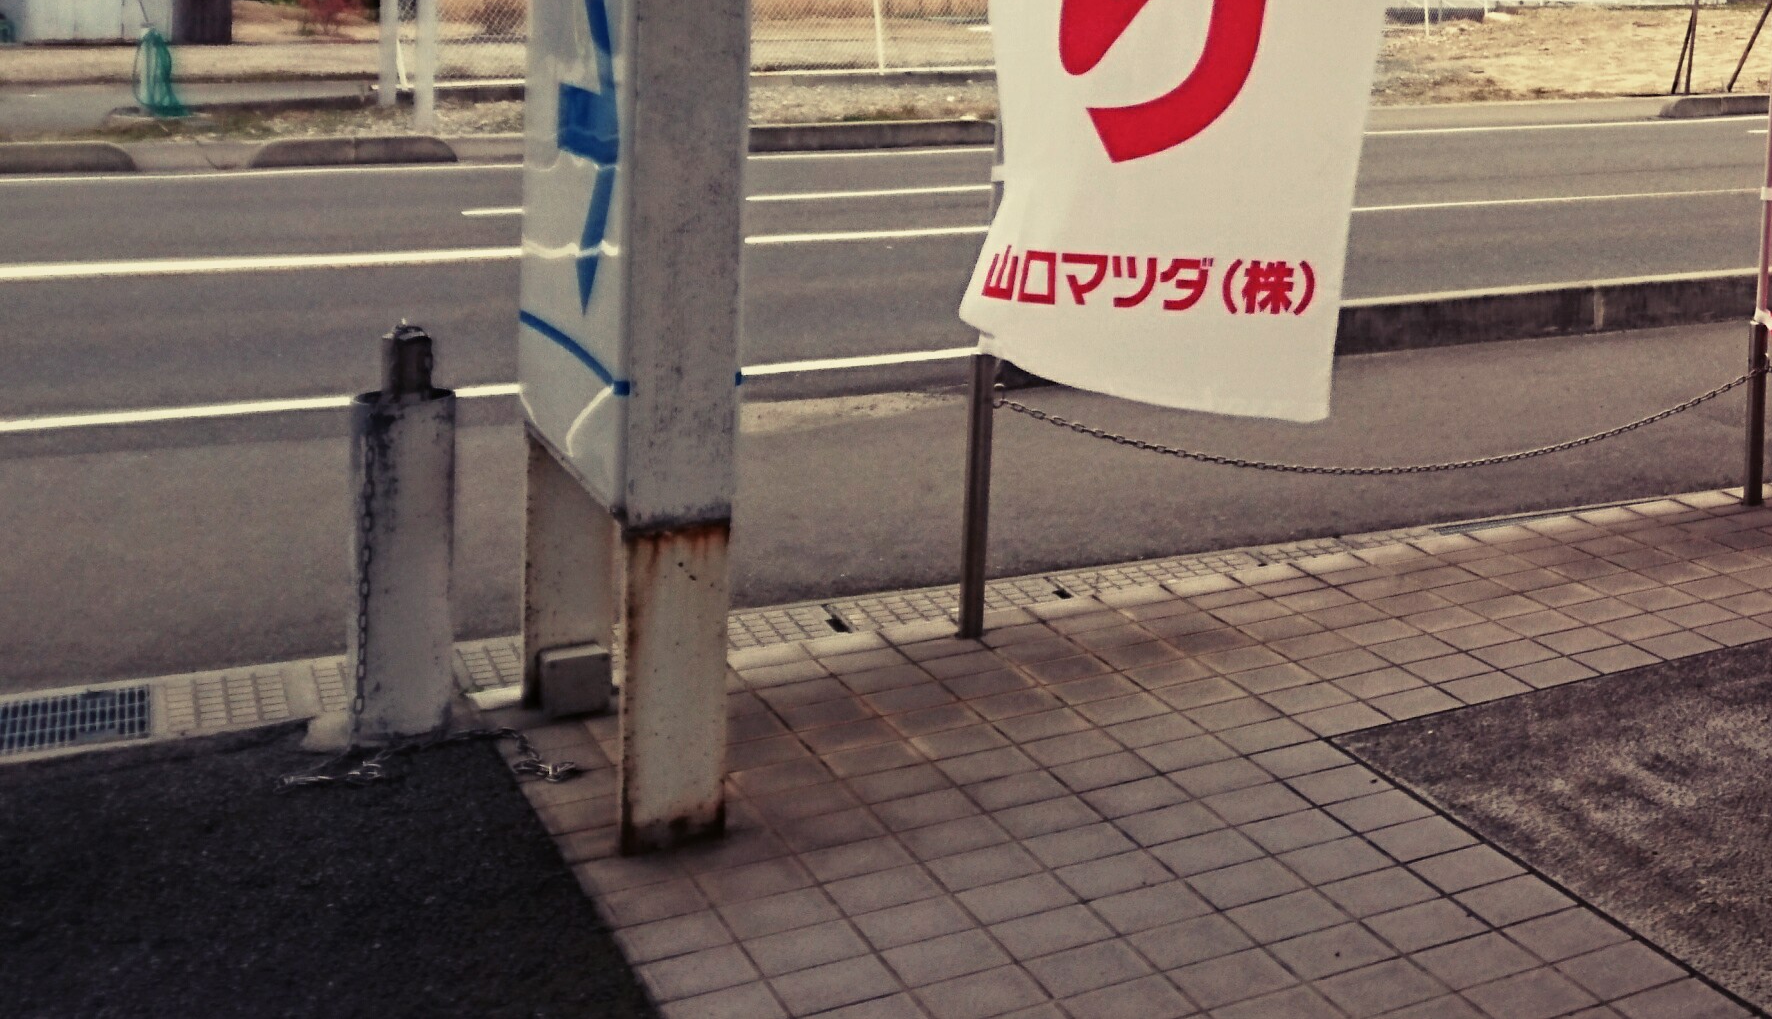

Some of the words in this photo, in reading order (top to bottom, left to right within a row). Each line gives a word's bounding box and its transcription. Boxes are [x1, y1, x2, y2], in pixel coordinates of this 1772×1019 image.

[981, 244, 1317, 316] 山口マツダ（株）
